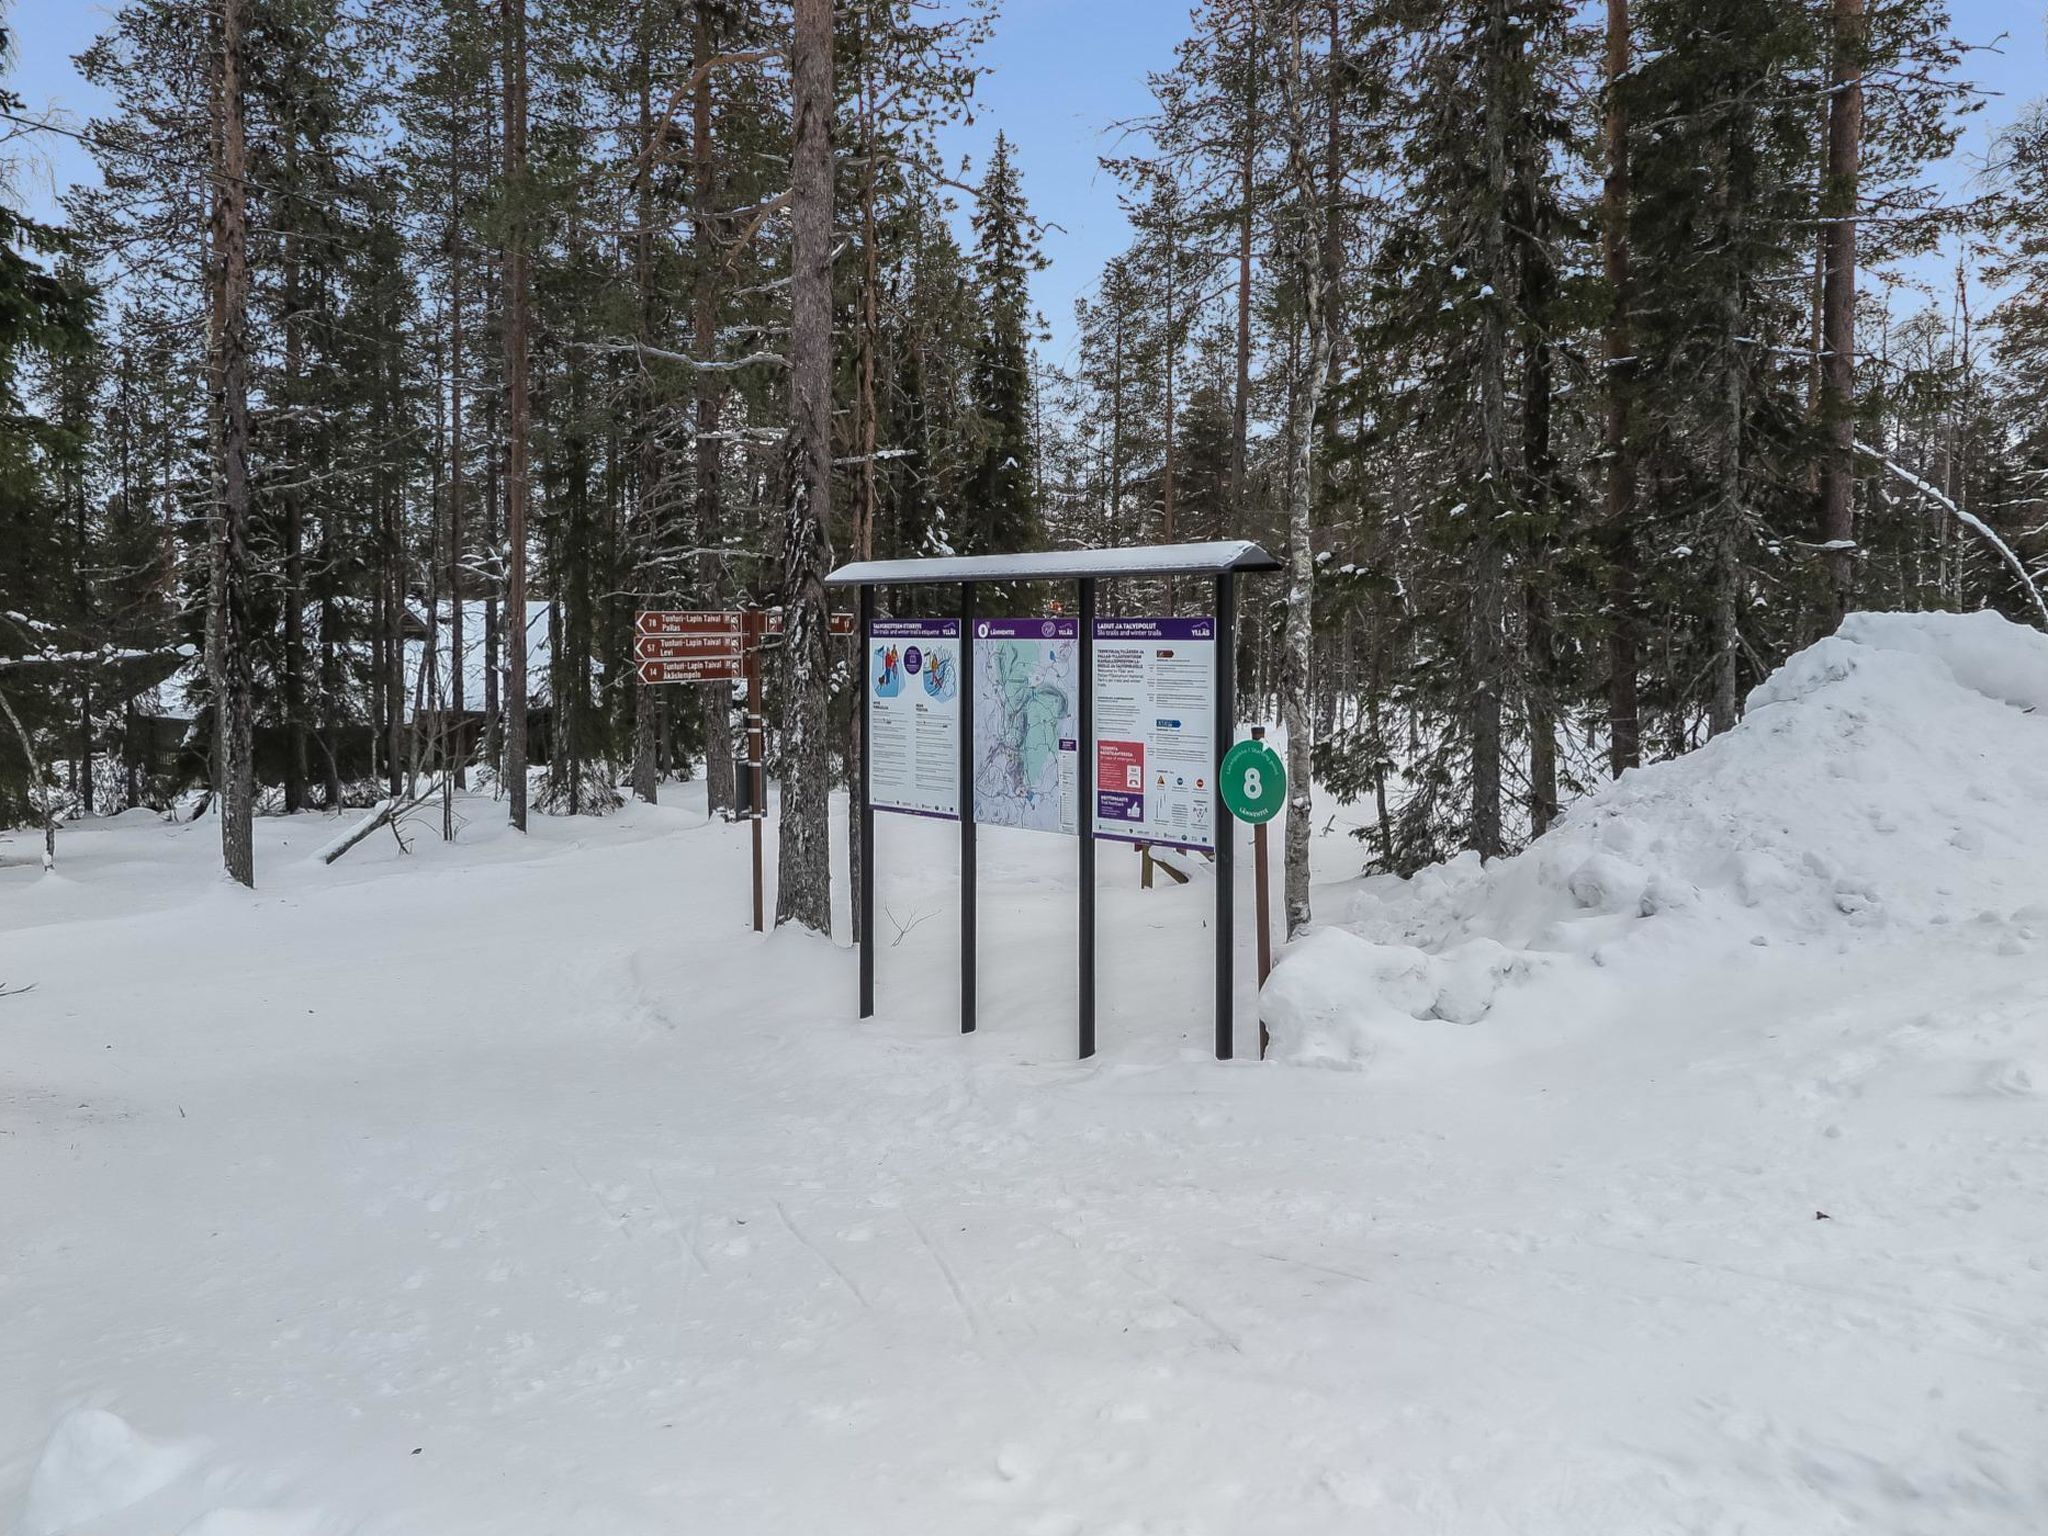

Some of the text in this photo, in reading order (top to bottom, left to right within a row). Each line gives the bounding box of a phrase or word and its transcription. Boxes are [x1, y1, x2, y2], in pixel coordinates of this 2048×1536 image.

[703, 614, 721, 622] Taival
[1191, 628, 1210, 637] YLLÄS
[650, 668, 657, 676] 14
[1243, 767, 1263, 800] 8
